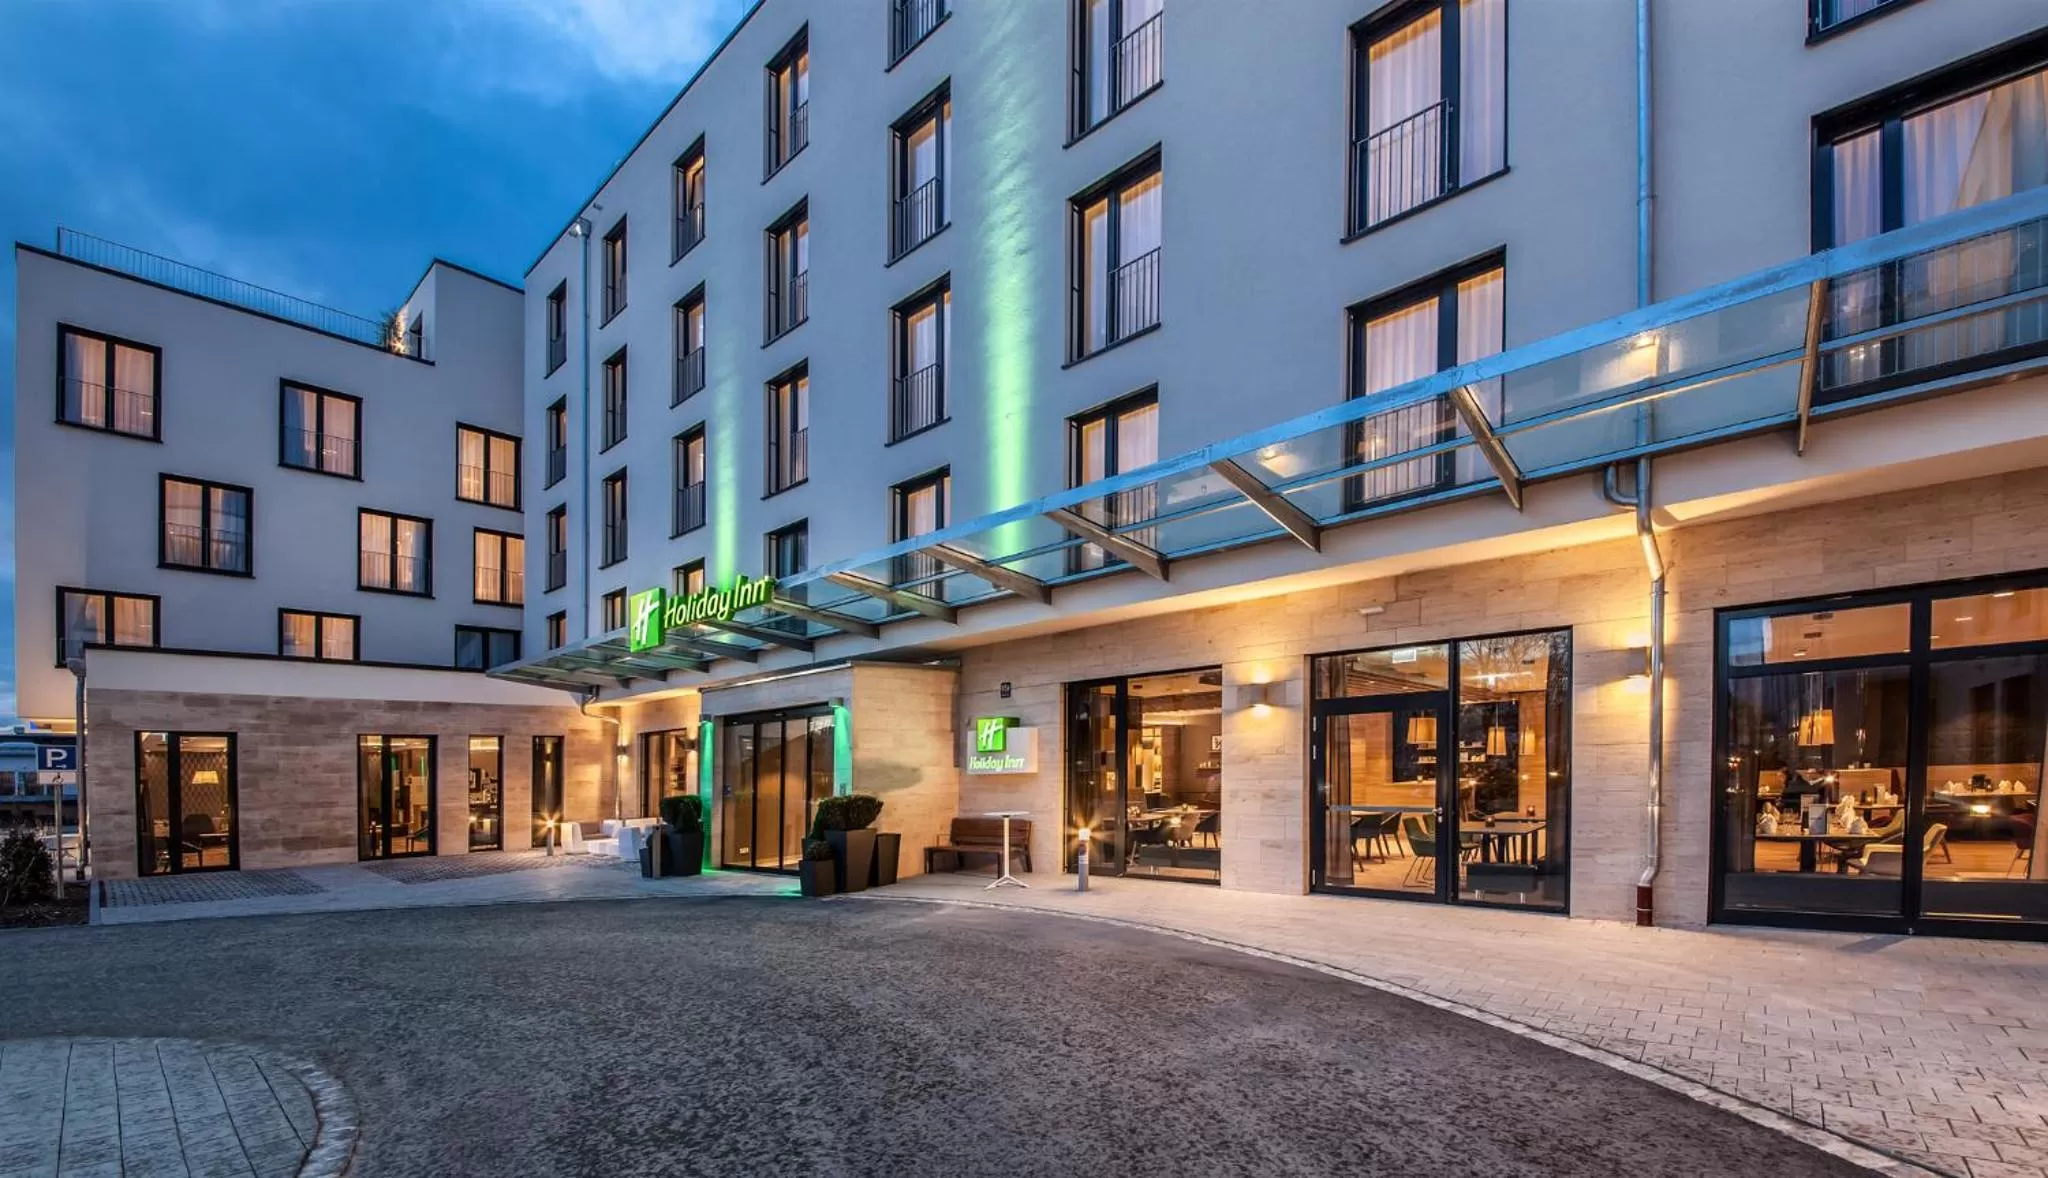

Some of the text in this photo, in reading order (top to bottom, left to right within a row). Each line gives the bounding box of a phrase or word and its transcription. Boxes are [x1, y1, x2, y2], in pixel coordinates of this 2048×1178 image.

[664, 577, 766, 629] Holiday Inn
[46, 747, 68, 768] P
[970, 755, 1025, 771] Holiday Inn
